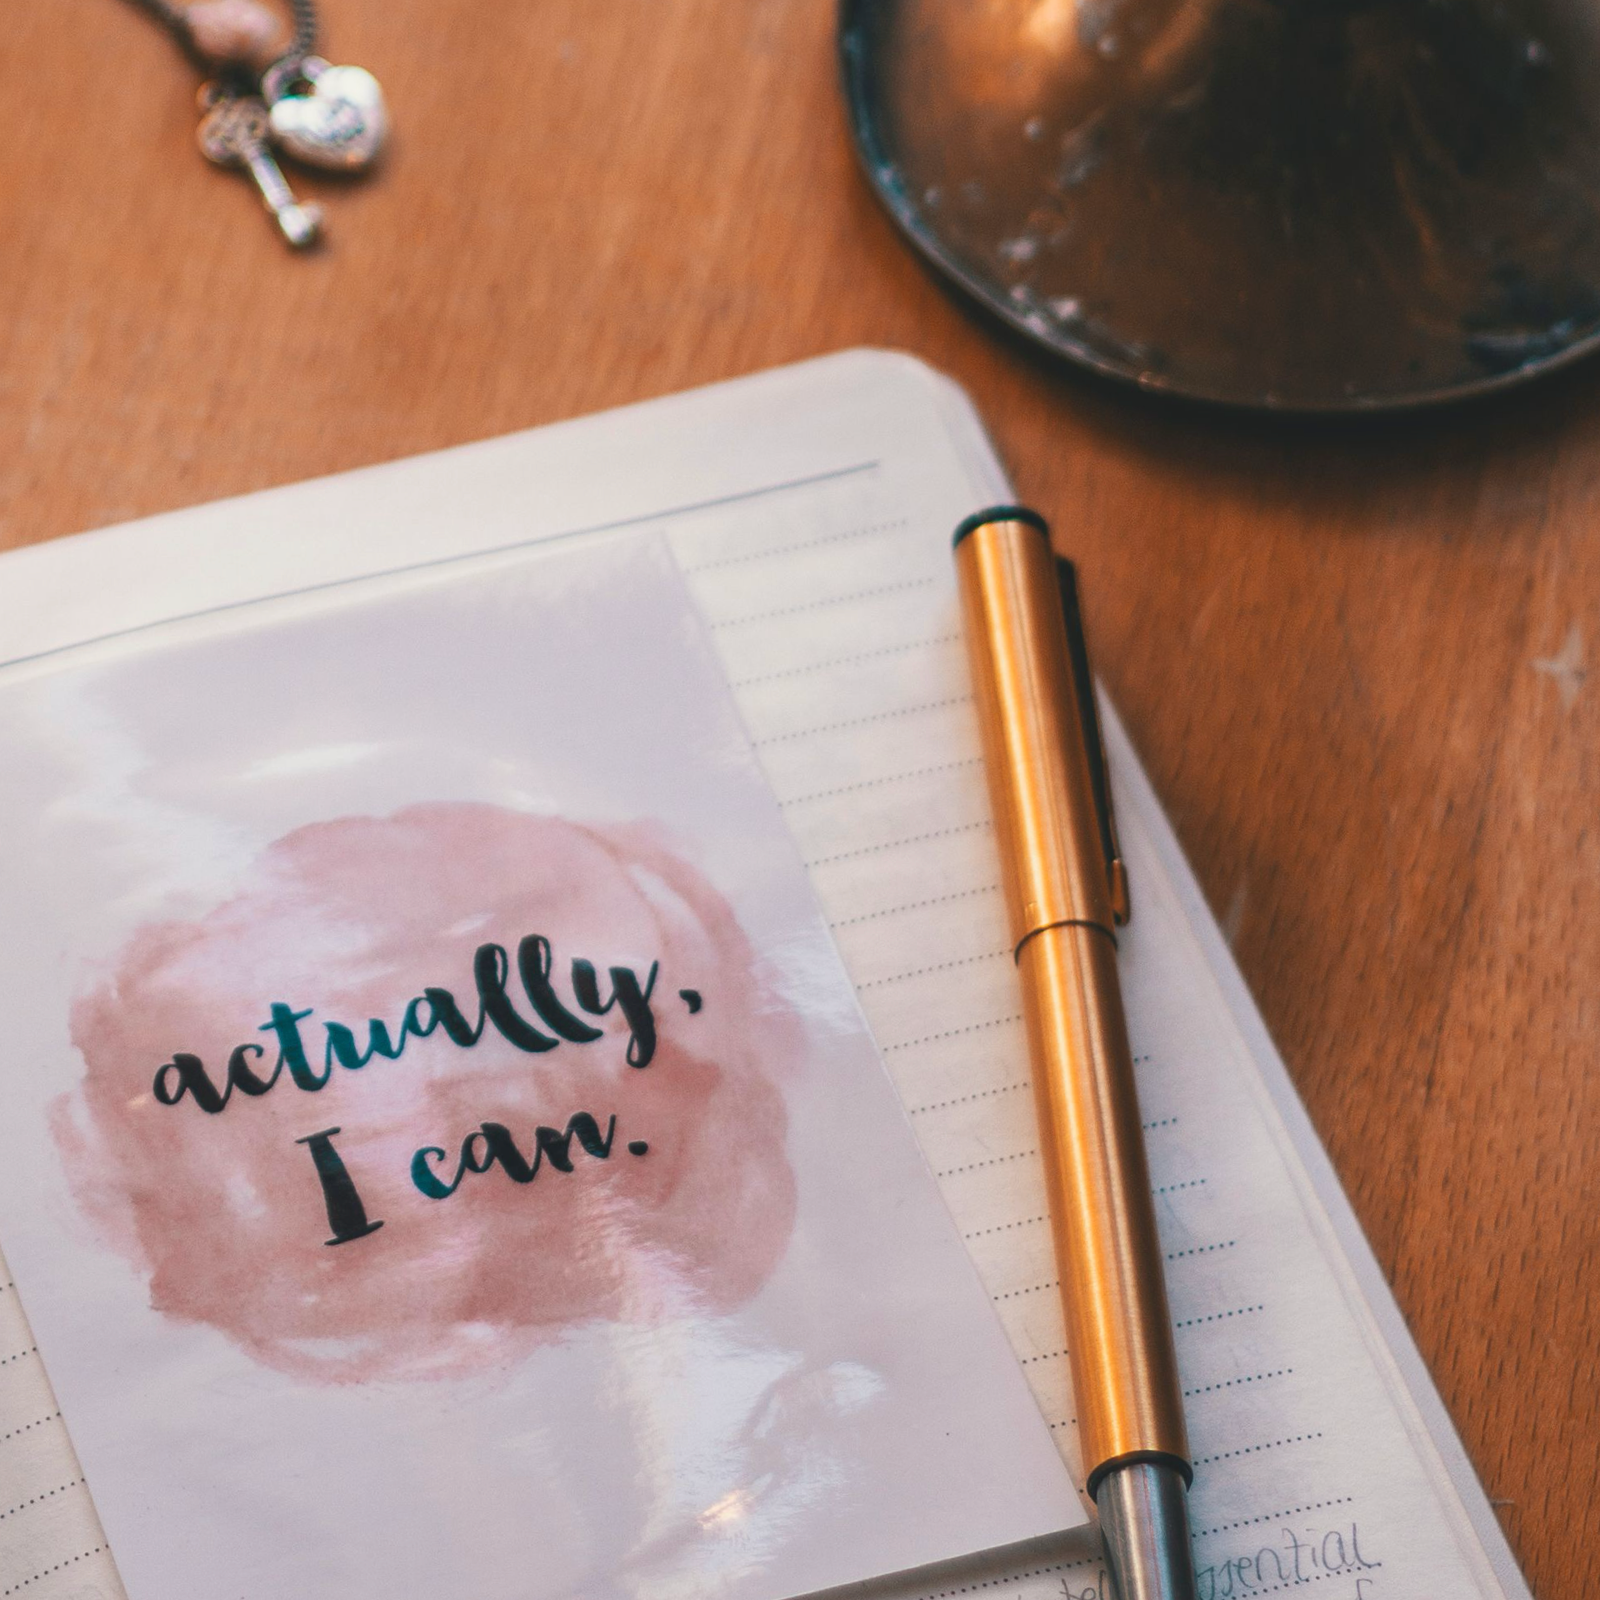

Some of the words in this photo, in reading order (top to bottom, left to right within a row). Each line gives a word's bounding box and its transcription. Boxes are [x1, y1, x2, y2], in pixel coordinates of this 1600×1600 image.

[152, 933, 703, 1114] actually,
[295, 1126, 385, 1246] I
[410, 1110, 650, 1200] can.
[1197, 1521, 1383, 1600] ssential
